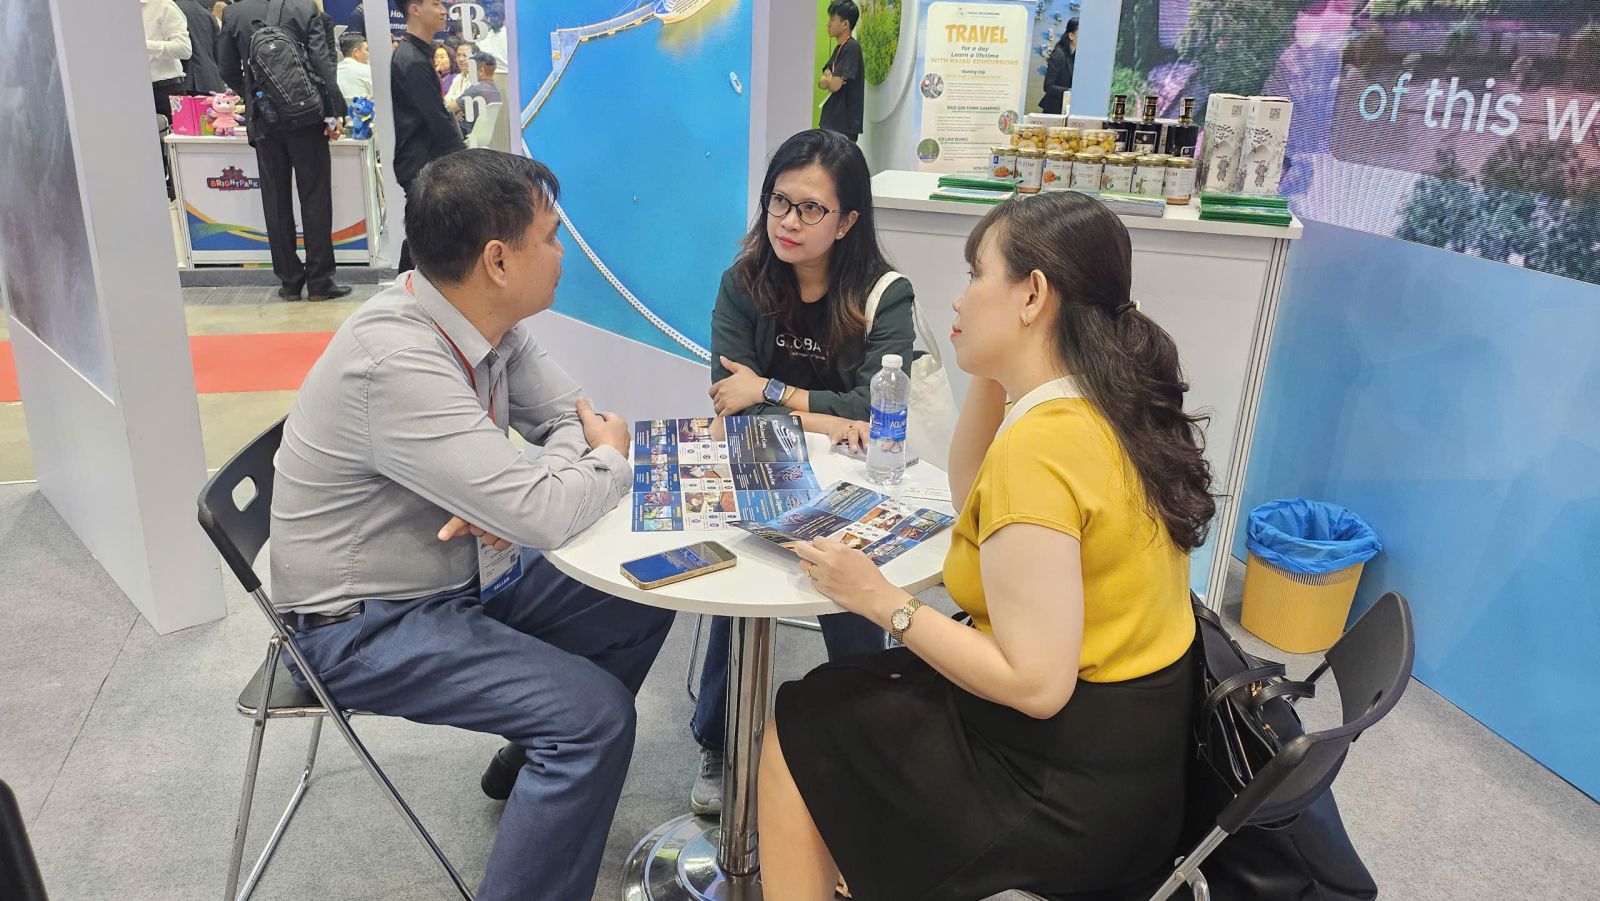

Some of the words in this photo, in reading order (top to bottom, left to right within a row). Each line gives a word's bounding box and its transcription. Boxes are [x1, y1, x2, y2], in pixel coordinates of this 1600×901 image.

[945, 24, 1008, 44] TRAVEL
[1358, 71, 1413, 123] of
[1423, 76, 1523, 137] this
[1546, 97, 1600, 145] w
[210, 179, 259, 188] BRIGHTPARK
[775, 334, 822, 353] GOBA
